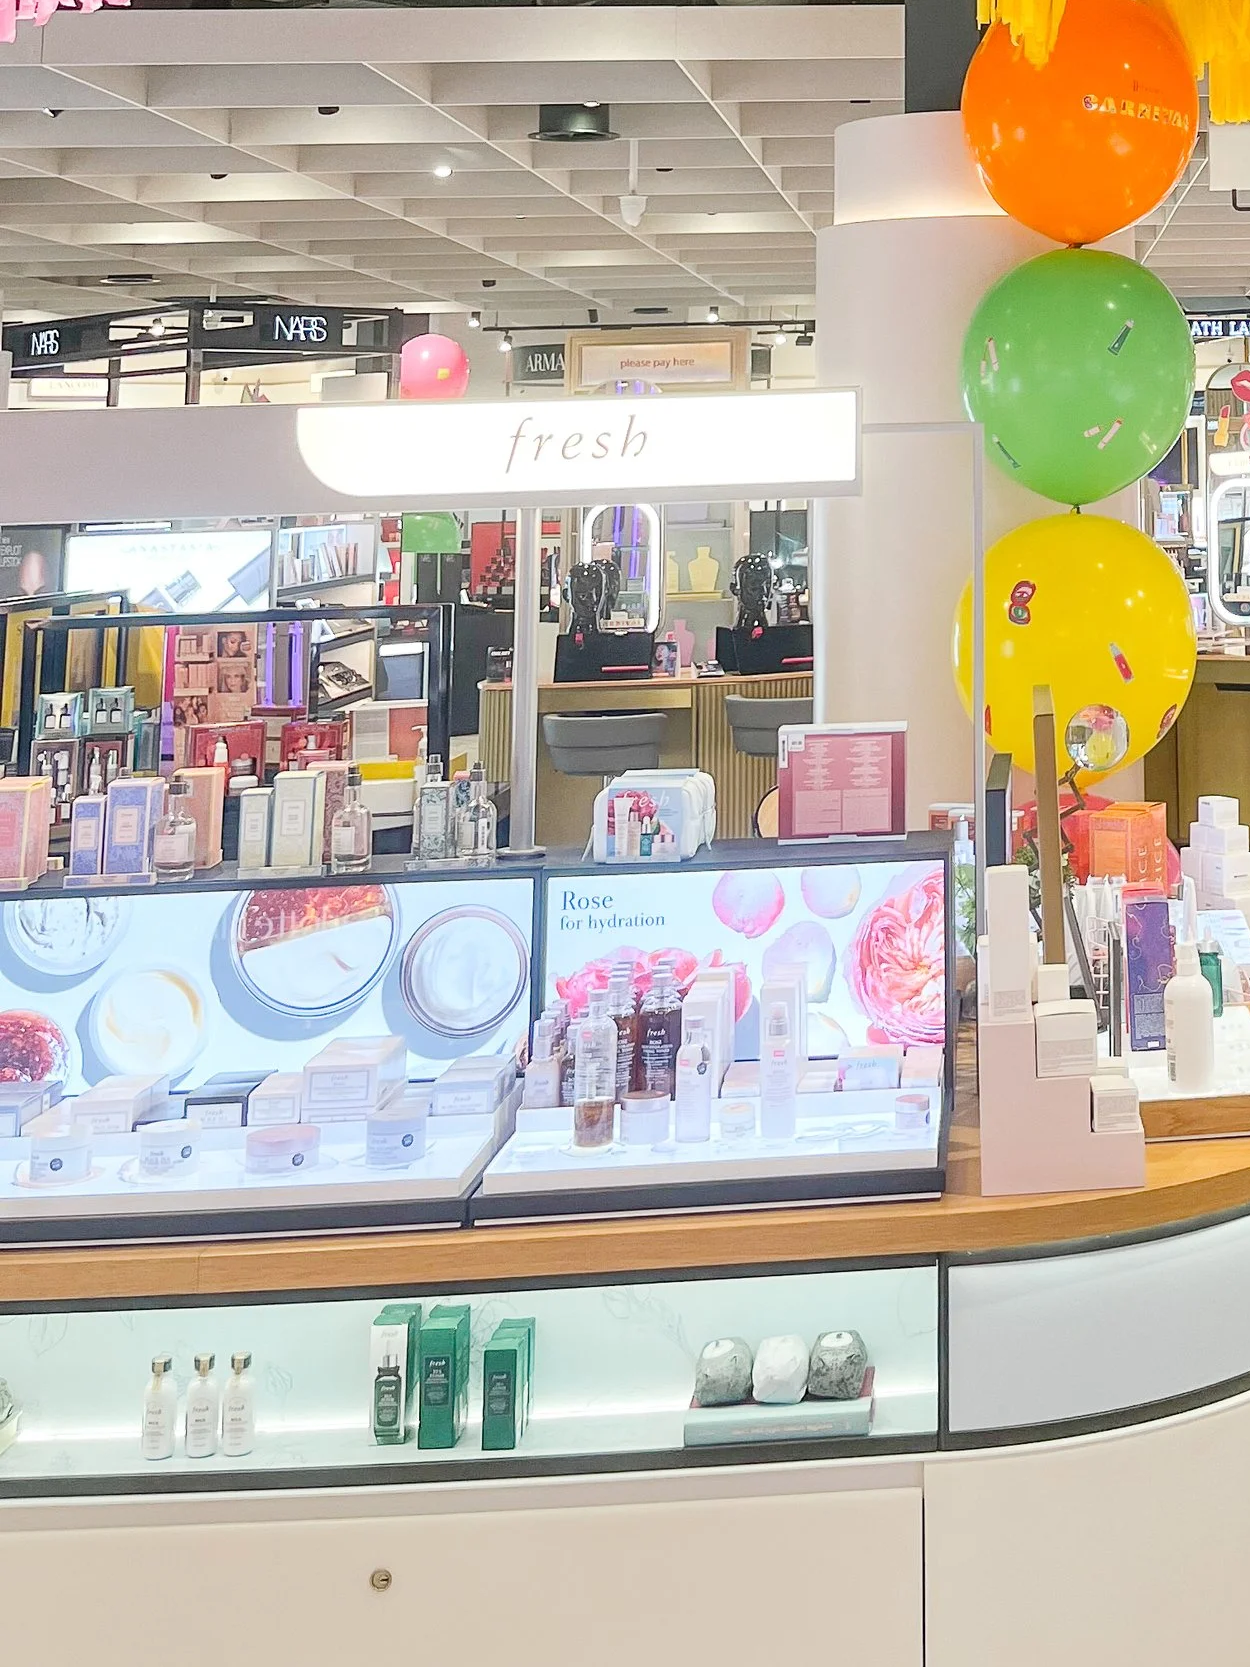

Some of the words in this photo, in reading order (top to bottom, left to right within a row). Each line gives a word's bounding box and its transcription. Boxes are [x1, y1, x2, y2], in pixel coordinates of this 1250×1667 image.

[273, 314, 329, 342] NARS
[31, 329, 60, 356] NARS
[619, 357, 651, 370] please
[652, 359, 671, 369] pay
[672, 356, 695, 367] here
[504, 413, 649, 475] fresh
[560, 890, 614, 911] Rose
[559, 915, 584, 931] for
[587, 913, 666, 934] hydration
